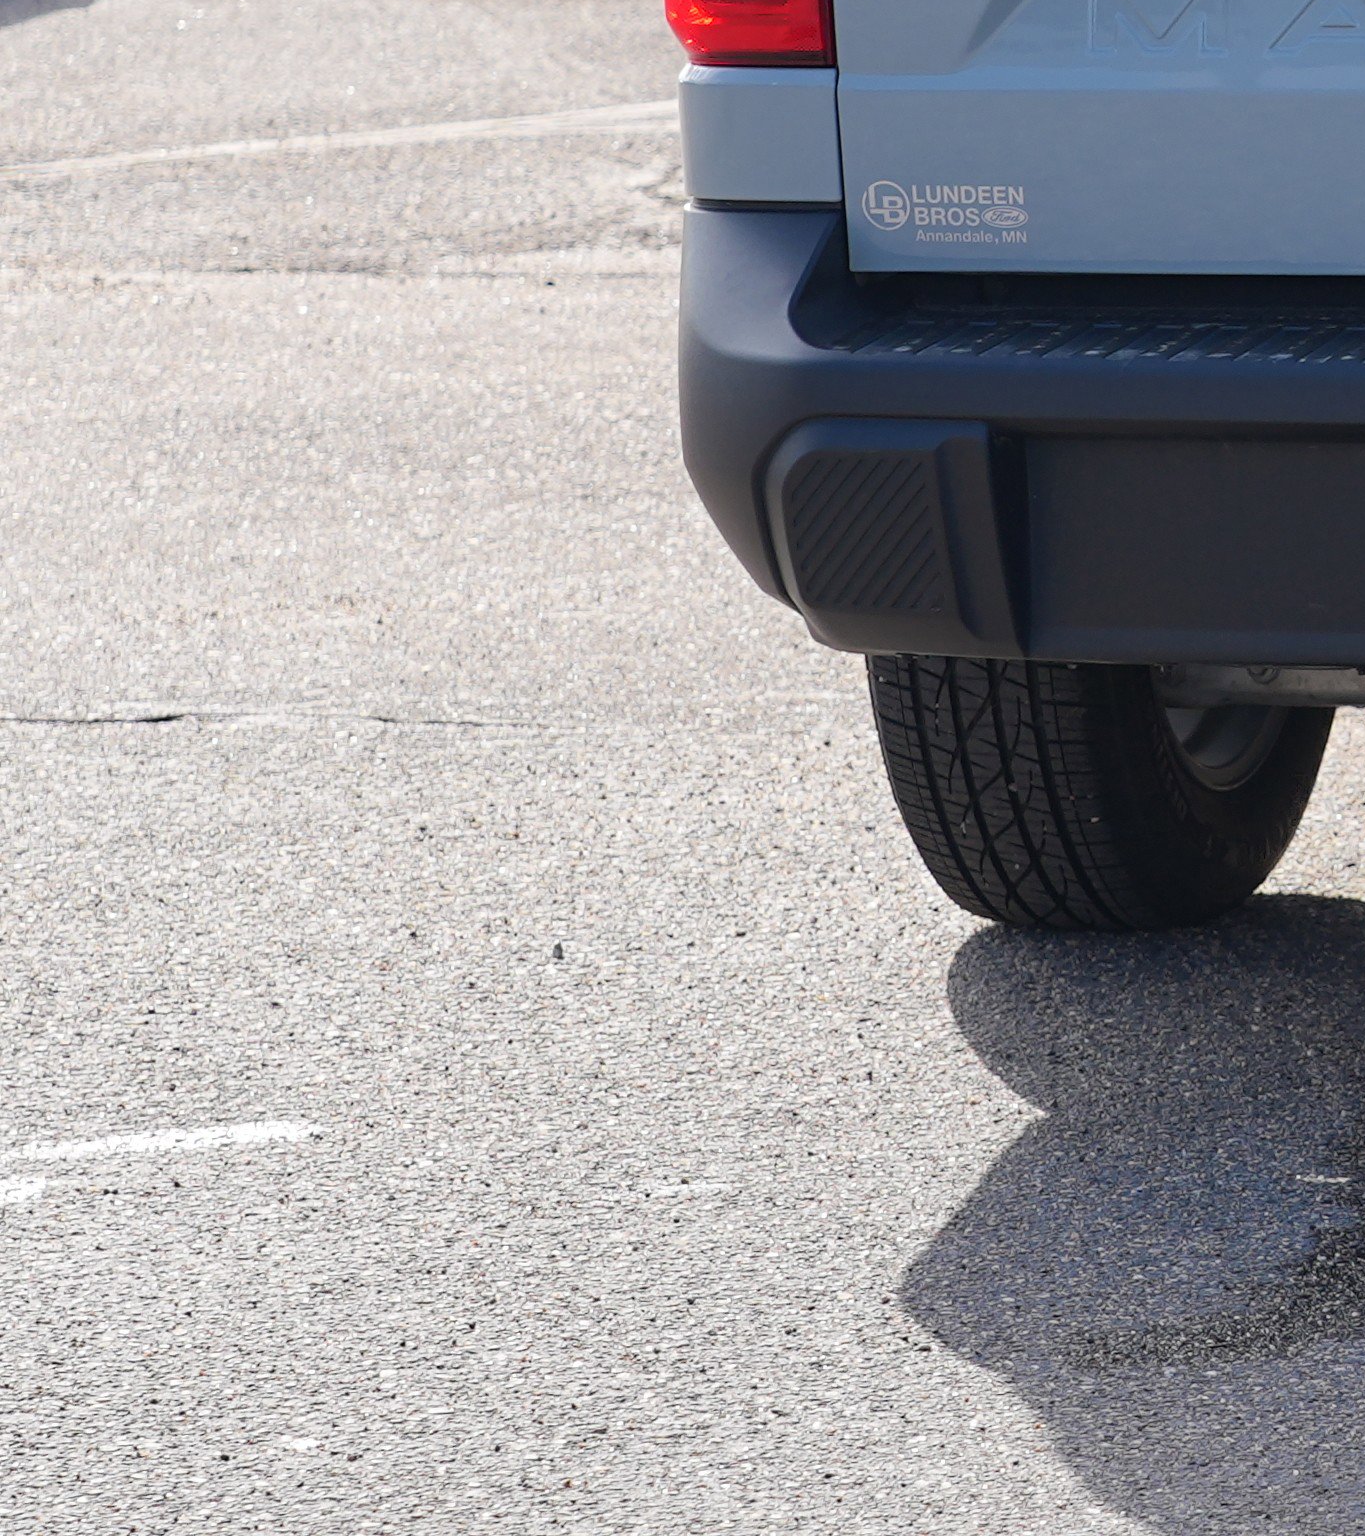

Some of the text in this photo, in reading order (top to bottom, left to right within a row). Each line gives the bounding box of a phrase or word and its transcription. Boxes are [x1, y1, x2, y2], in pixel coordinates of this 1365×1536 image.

[911, 184, 1024, 205] LUNDEEN
[914, 207, 980, 226] BROS
[916, 229, 1027, 245] Annandale, MN
